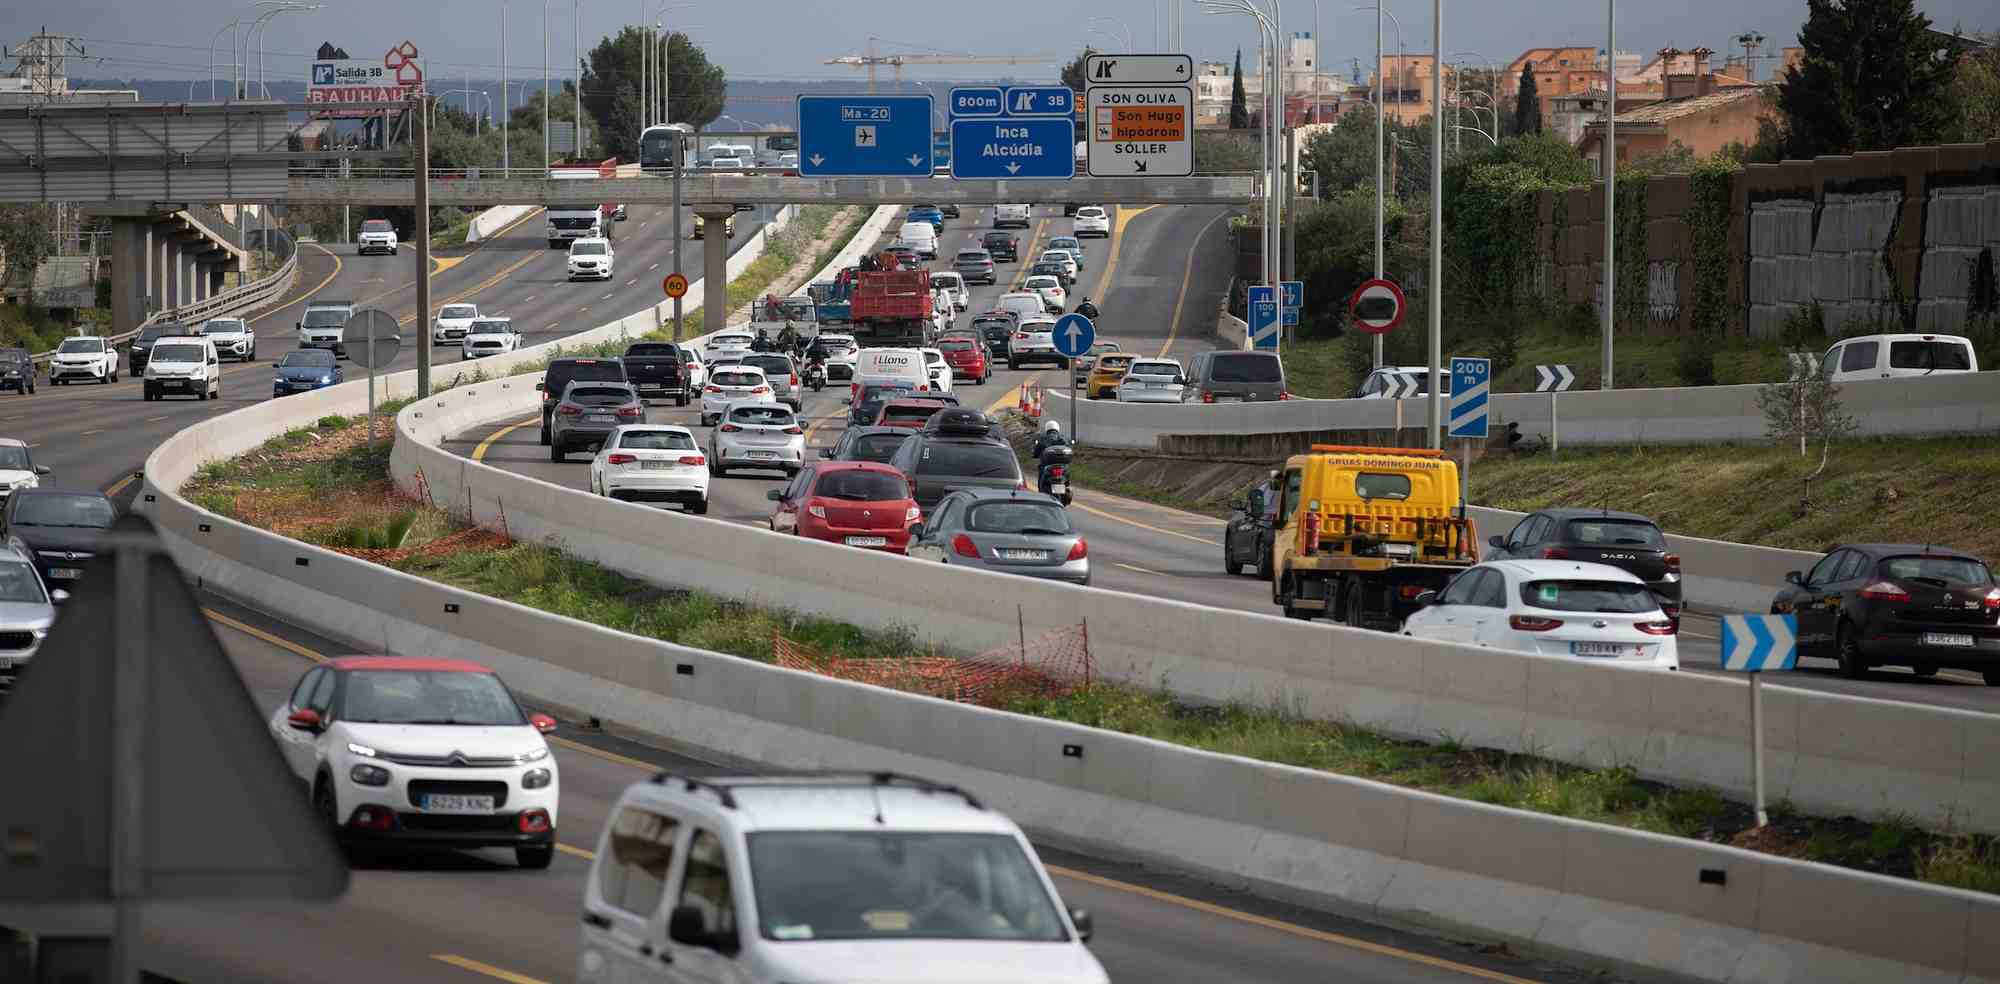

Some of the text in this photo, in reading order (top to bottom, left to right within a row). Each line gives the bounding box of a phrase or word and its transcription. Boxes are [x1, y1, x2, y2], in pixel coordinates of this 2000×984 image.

[336, 67, 382, 78] Salida 3B
[1176, 64, 1185, 73] 4
[312, 87, 422, 103] BAUHAU
[1103, 94, 1176, 104] SON OLIVA
[958, 96, 997, 107] 800m
[1047, 96, 1065, 106] 3B
[1117, 111, 1182, 123] Son Hugo
[995, 125, 1029, 138] Inca
[982, 143, 1042, 157] Alcúdia
[1456, 362, 1486, 375] 200
[1464, 375, 1476, 385] m
[1328, 458, 1440, 470] GRUAS DOMINGO JUAN
